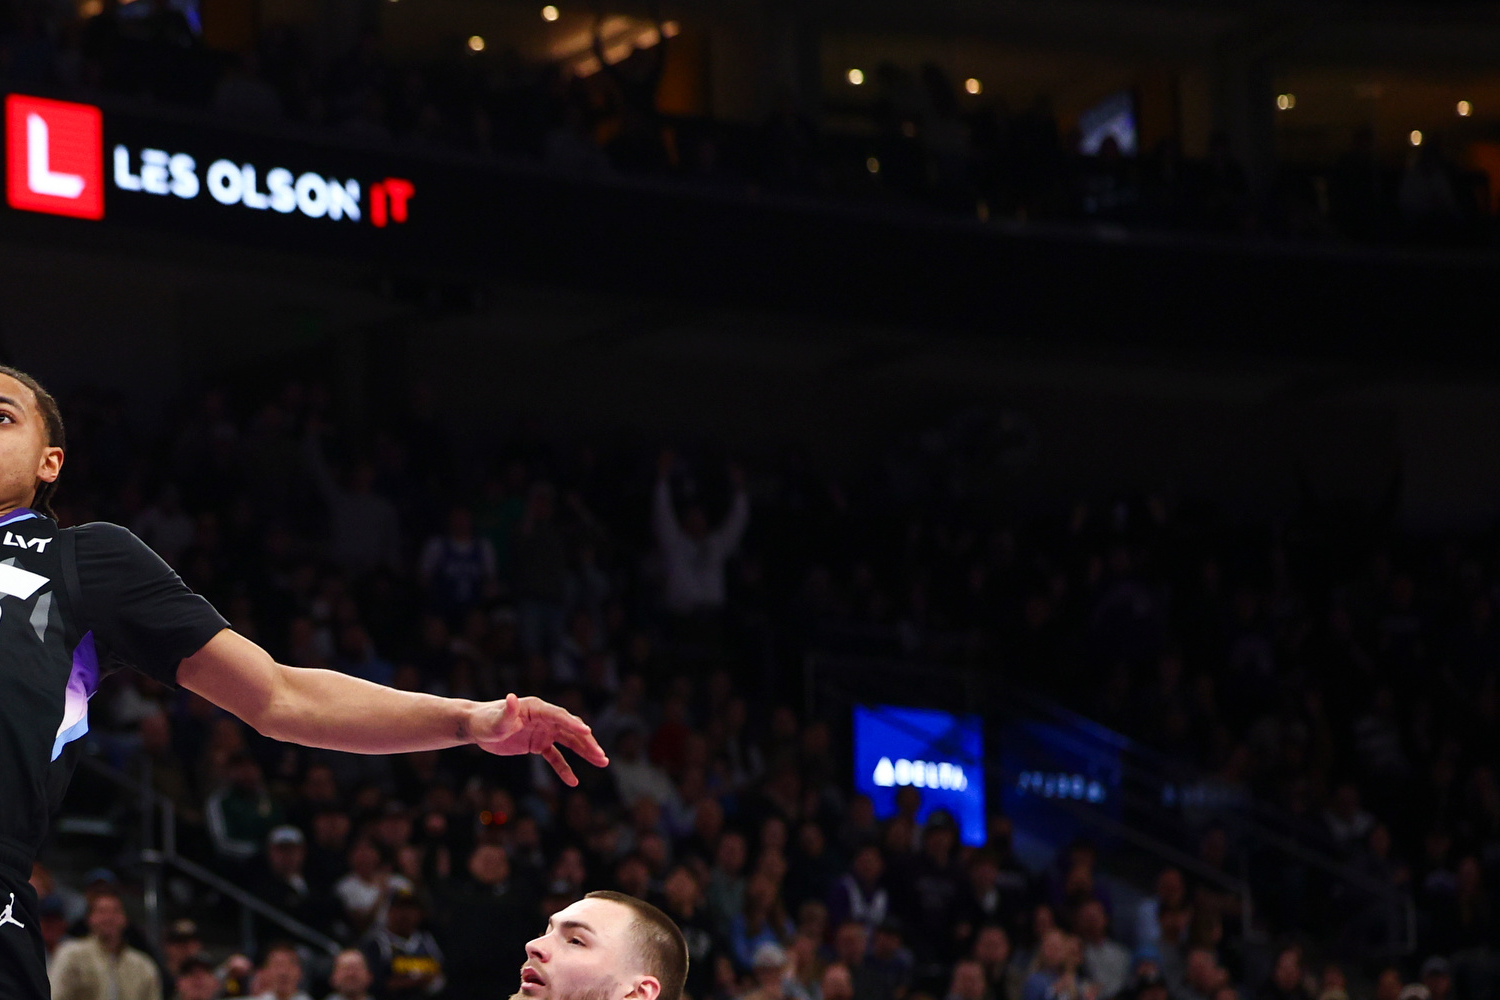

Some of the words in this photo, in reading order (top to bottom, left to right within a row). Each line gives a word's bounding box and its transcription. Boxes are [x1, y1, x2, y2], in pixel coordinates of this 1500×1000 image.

[26, 112, 85, 199] L
[113, 143, 200, 199] LES
[206, 158, 361, 222] OLSON
[369, 176, 416, 228] IT
[3, 531, 53, 553] LVT
